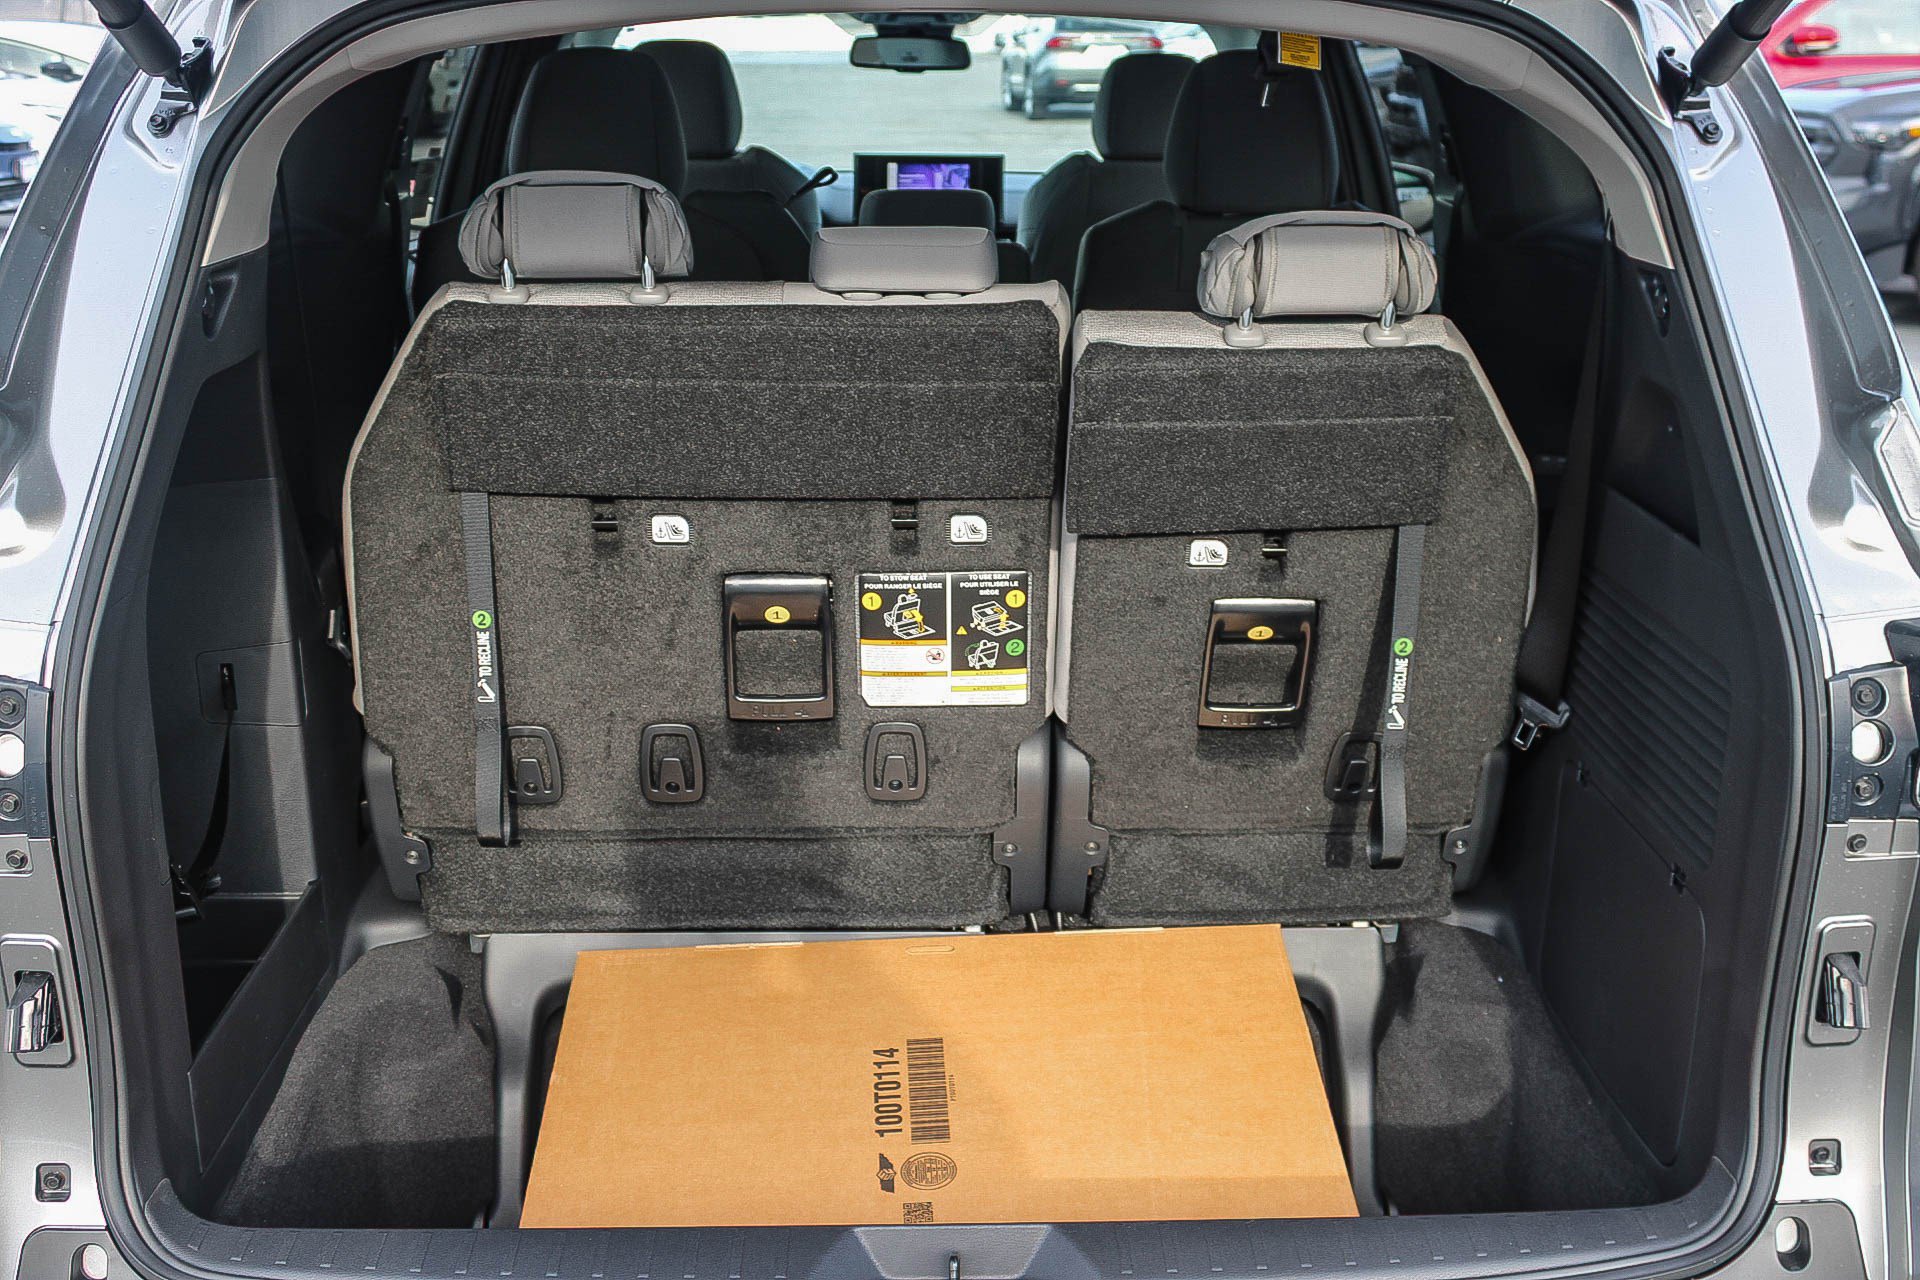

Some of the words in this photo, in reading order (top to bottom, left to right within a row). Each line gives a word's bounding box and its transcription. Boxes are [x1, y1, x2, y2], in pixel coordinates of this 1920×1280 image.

[880, 574, 889, 582] TO
[1009, 580, 1019, 588] LE
[477, 631, 491, 665] RECLINE
[478, 665, 493, 678] TO
[1392, 658, 1408, 692] RECLINE
[1391, 692, 1406, 705] TO
[872, 1047, 903, 1138] 100T0114
